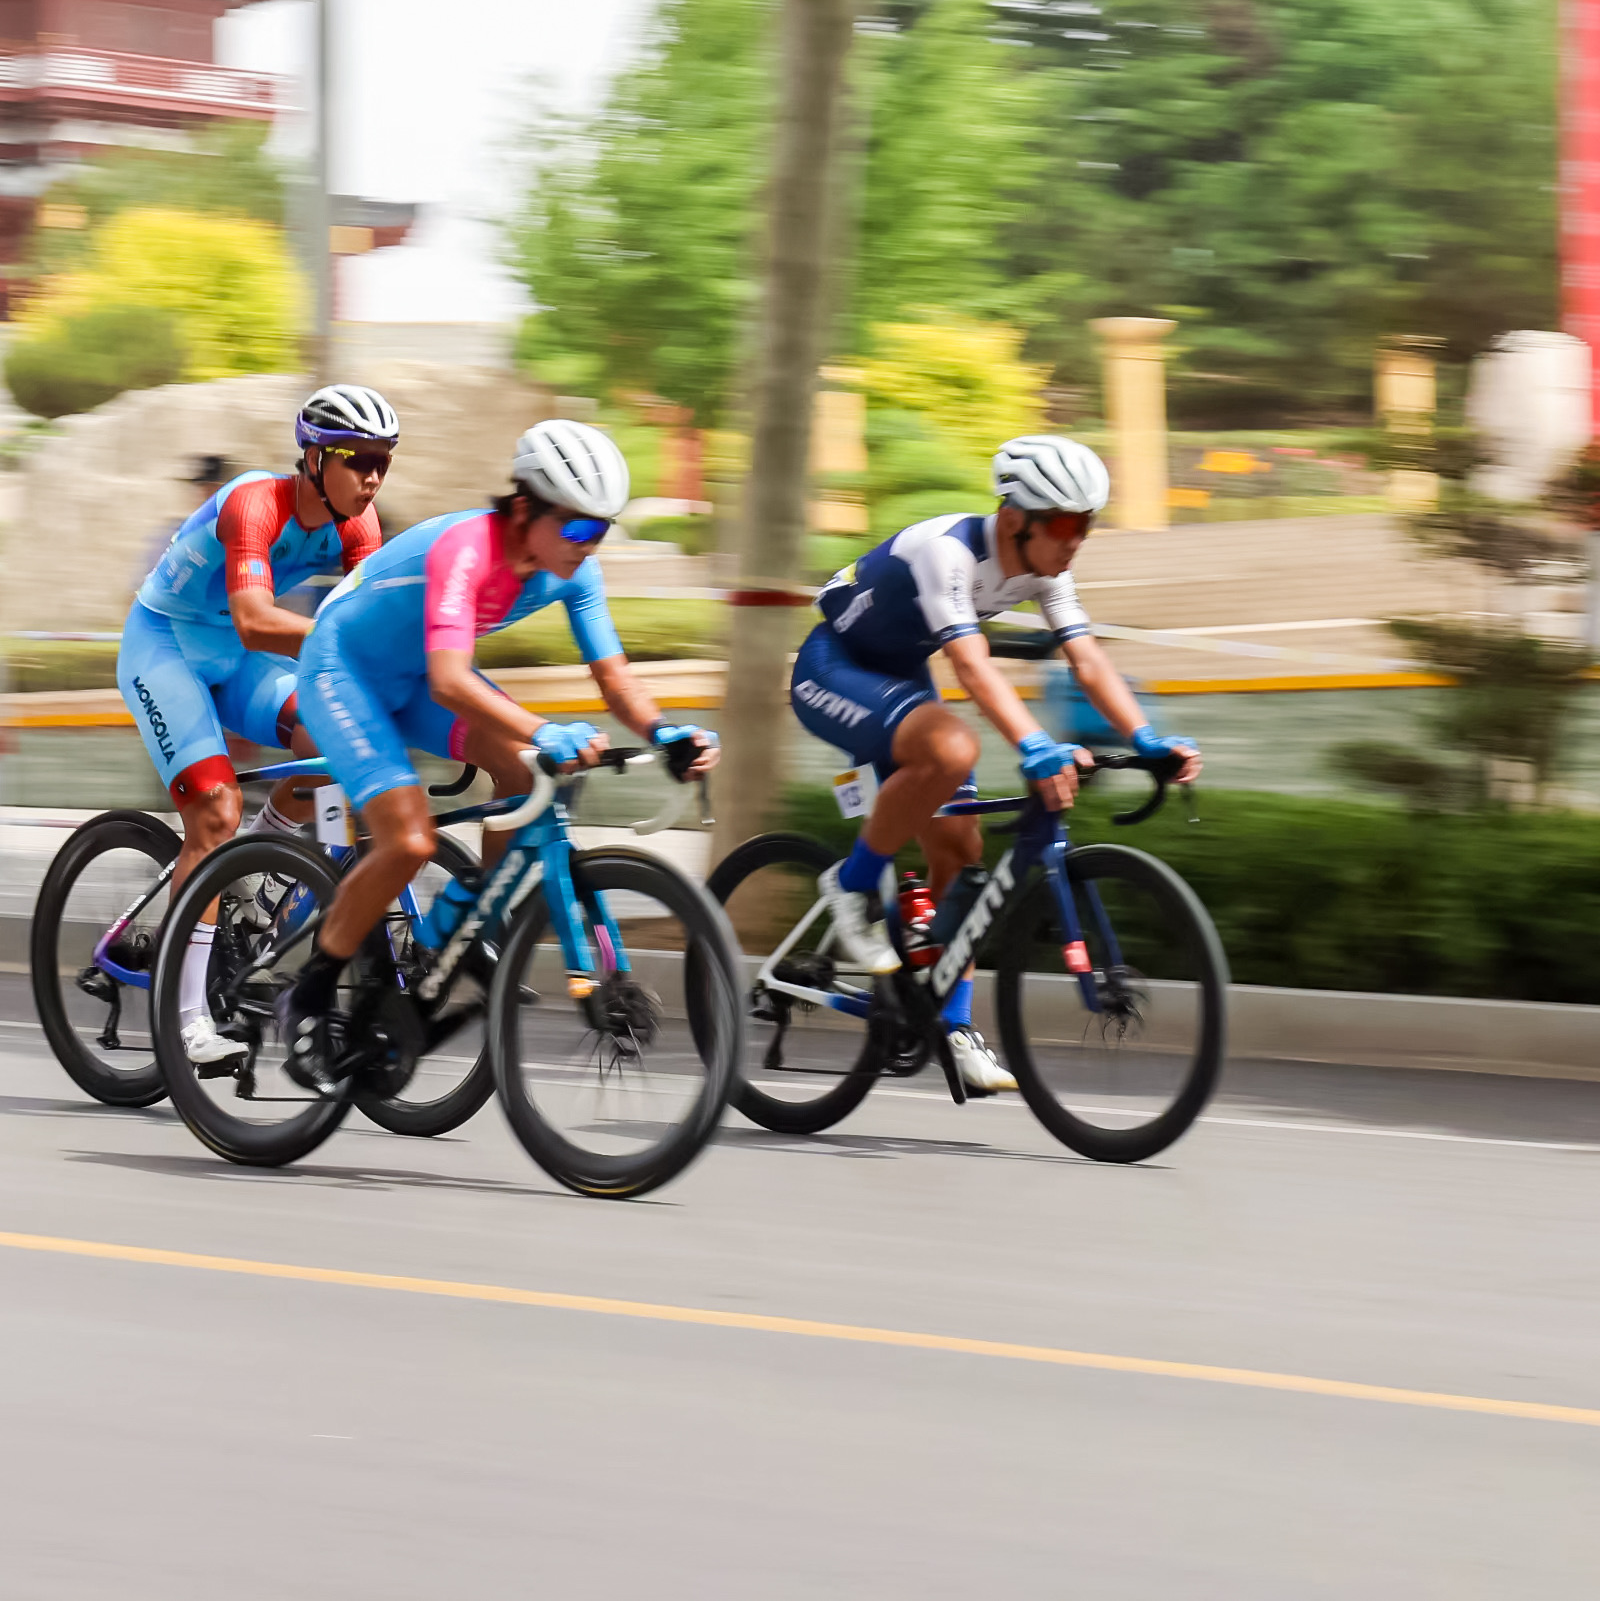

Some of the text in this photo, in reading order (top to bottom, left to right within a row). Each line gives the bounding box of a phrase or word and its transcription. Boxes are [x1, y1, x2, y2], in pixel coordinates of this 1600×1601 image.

[132, 675, 176, 766] MONGOLIA
[794, 679, 873, 729] GIANT
[931, 846, 1016, 998] GIANT
